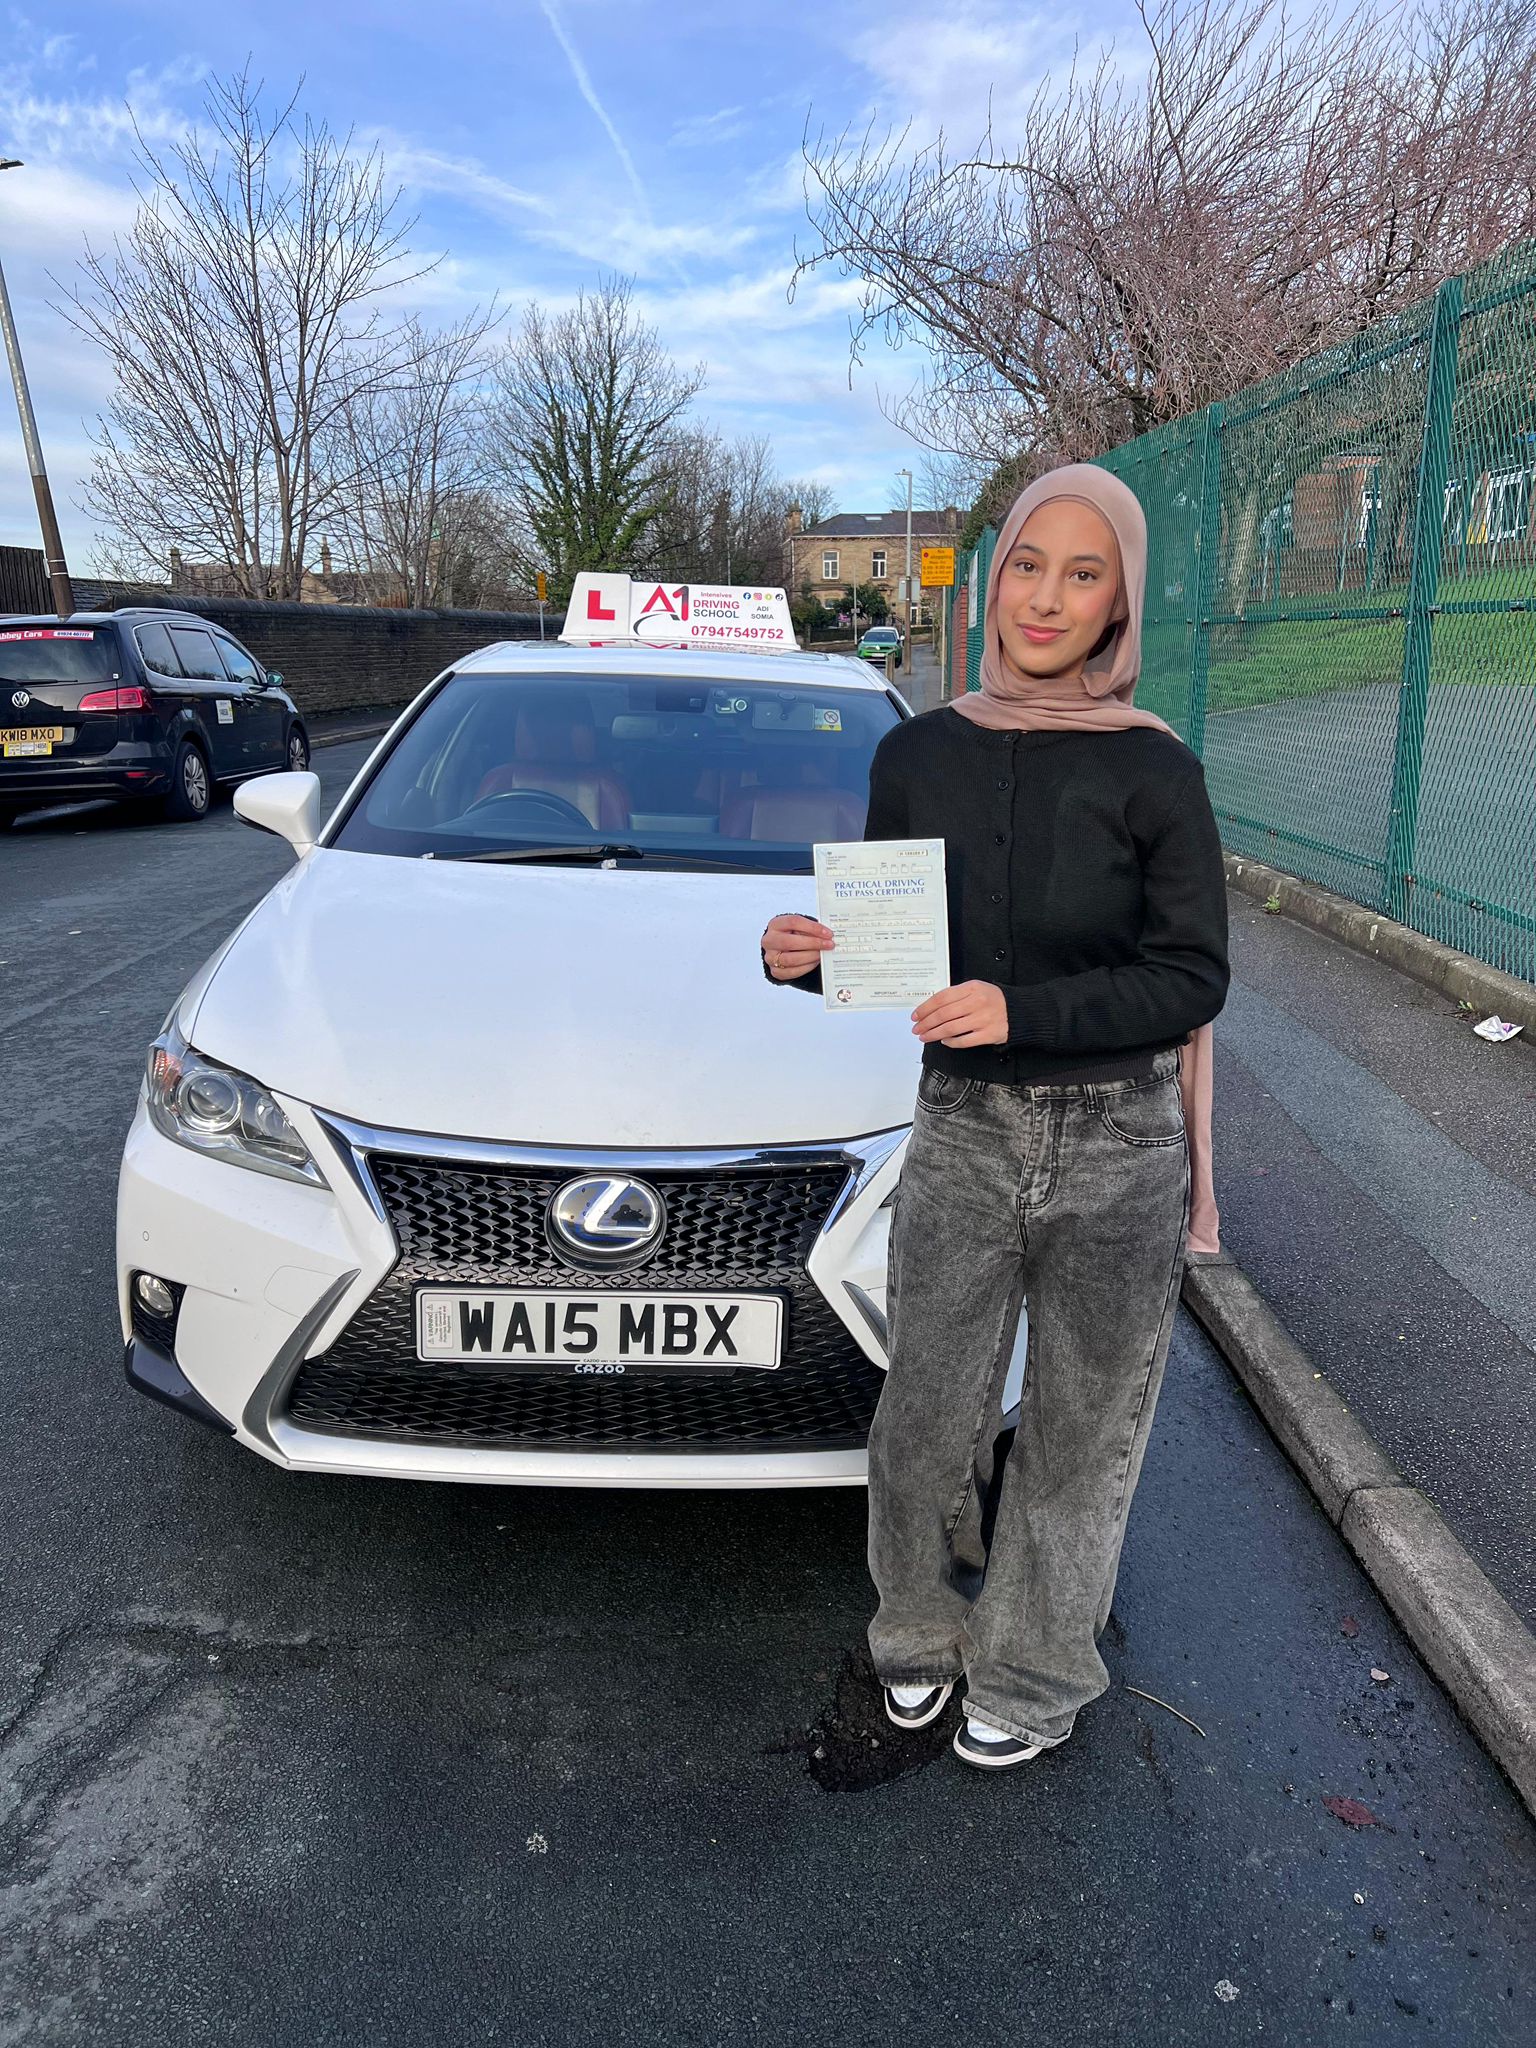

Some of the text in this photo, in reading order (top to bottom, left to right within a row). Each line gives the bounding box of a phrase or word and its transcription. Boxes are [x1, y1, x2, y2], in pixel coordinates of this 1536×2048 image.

[700, 591, 733, 599] Intensives
[588, 590, 615, 620] L
[693, 599, 740, 610] DRIVING
[693, 608, 740, 619] SCHOOL
[23, 630, 43, 638] Cars
[691, 625, 784, 640] 07947549752
[0, 728, 55, 742] KW18 MXO
[834, 878, 925, 890] PRACTICAL DRIVING
[836, 886, 925, 898] TEST PASS CERTIFICATE
[459, 1301, 739, 1356] WA15 MBX
[574, 1364, 625, 1374] CAZOO
